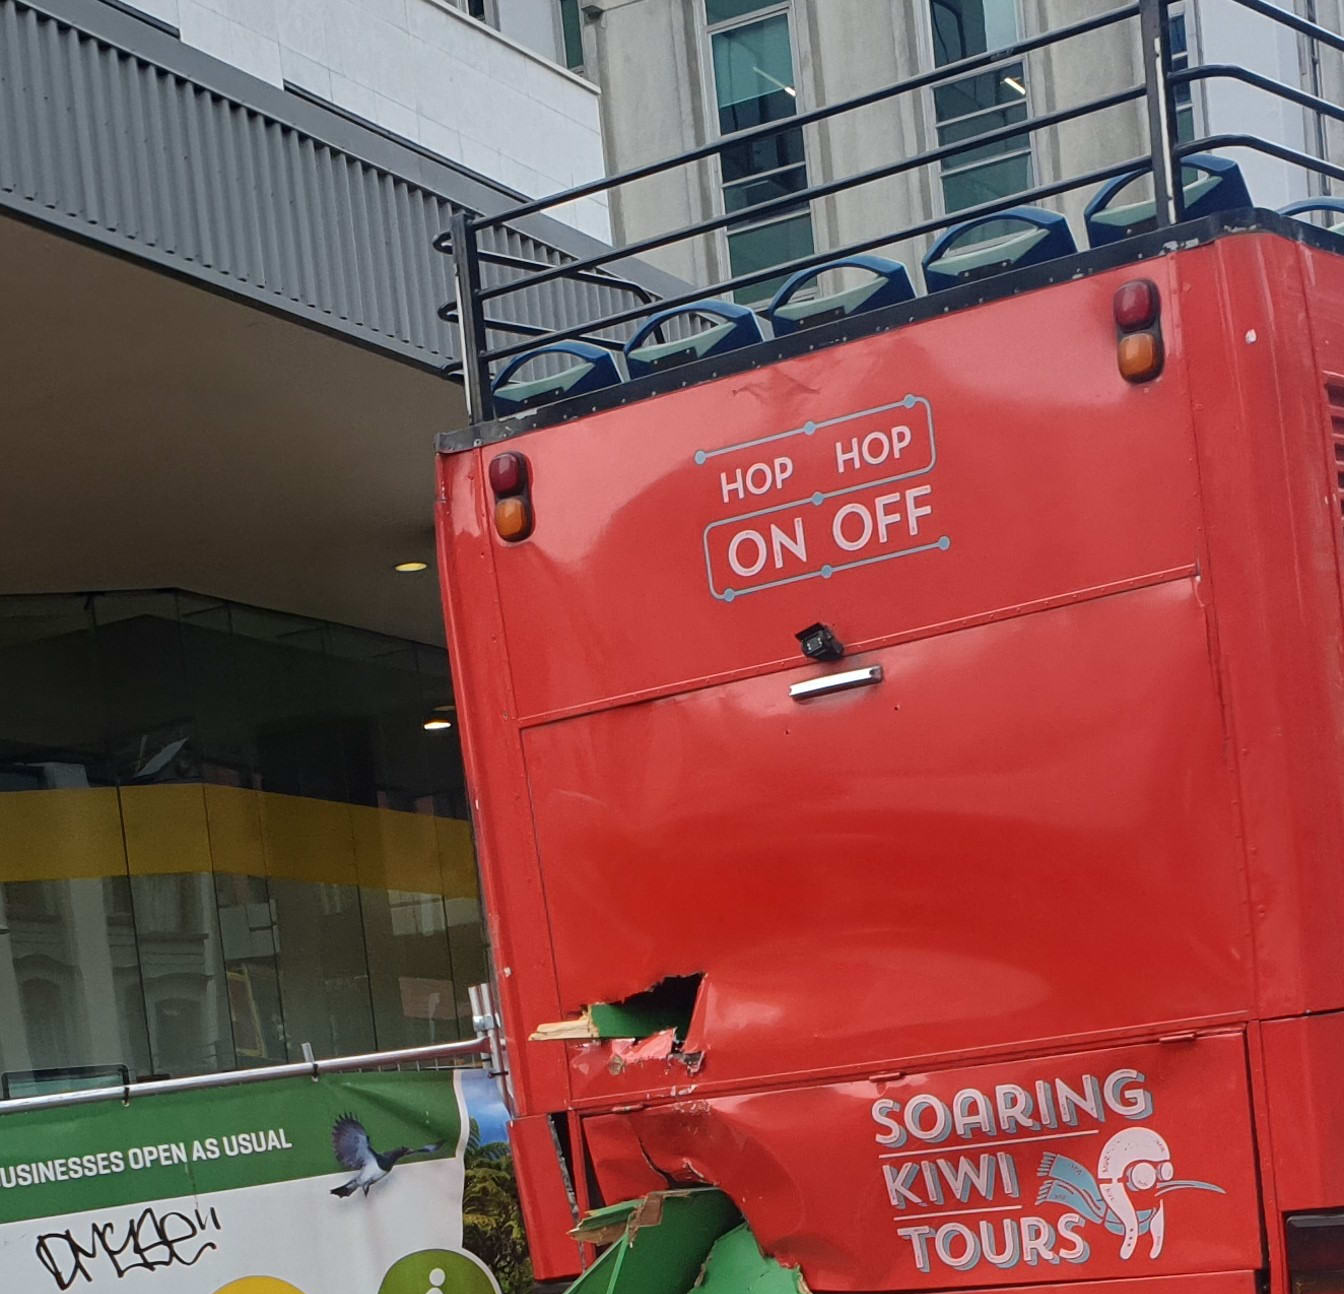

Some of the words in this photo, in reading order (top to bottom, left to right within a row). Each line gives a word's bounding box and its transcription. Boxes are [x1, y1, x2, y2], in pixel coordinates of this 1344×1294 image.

[719, 455, 794, 504] HOP
[834, 424, 913, 475] HOP
[726, 516, 808, 578] ON
[831, 483, 933, 553] OFF
[870, 1067, 1153, 1150] SOARING
[128, 1139, 188, 1170] OPEN
[191, 1136, 221, 1161] AS
[225, 1127, 293, 1158] USUAL
[881, 1150, 1020, 1208] KIWI
[897, 1212, 1091, 1274] TOURS
